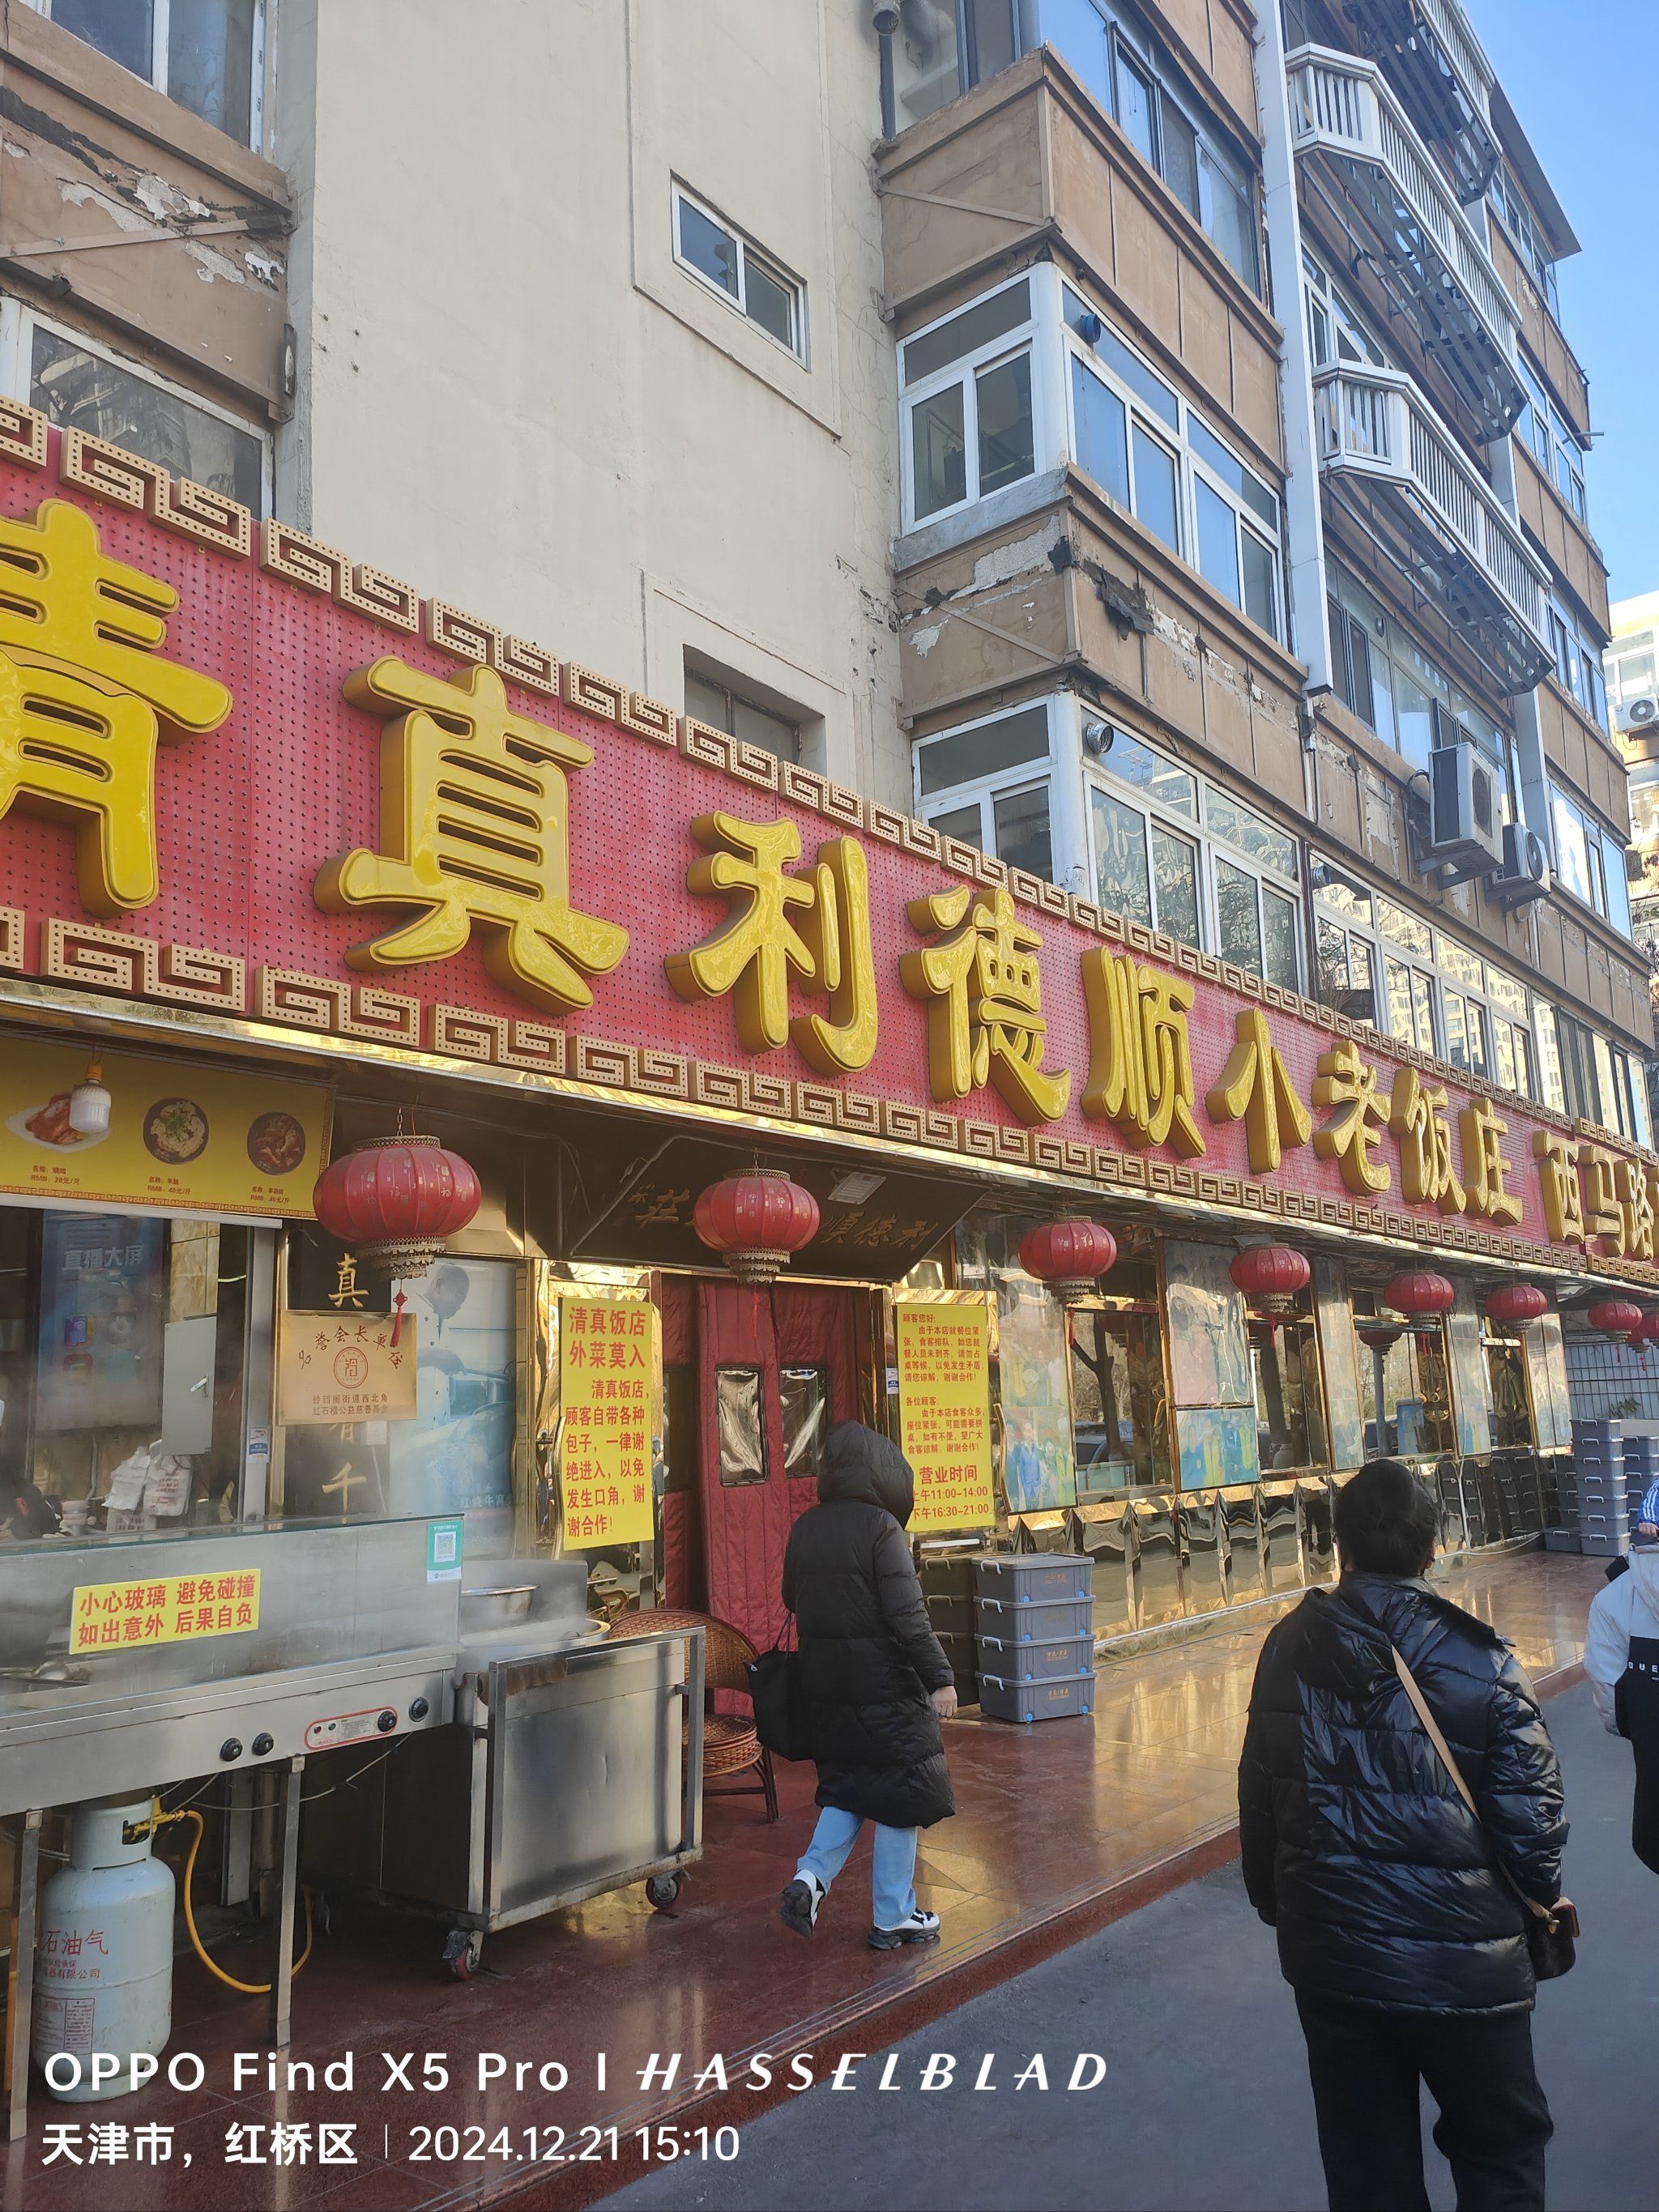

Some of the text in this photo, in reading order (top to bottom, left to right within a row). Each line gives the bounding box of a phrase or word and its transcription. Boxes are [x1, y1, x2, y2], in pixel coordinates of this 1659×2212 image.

[327, 1252, 369, 1308] 真
[569, 1306, 646, 1336] 清真饭店
[919, 1326, 979, 1335] 由于本店就餐位紧
[569, 1340, 646, 1370] 外菜莫入
[591, 1379, 650, 1400] 清真饭店，
[565, 1404, 645, 1426] 顾客自带各种
[565, 1431, 645, 1454] 包子，一律谢
[566, 1457, 645, 1481] 绝进入，以免
[919, 1464, 979, 1485] 营业时间
[567, 1483, 645, 1509] 发生口角，谢
[79, 1574, 255, 1617] 小心玻璃 避免碰撞
[78, 1602, 253, 1647] 如出意外 后果自负
